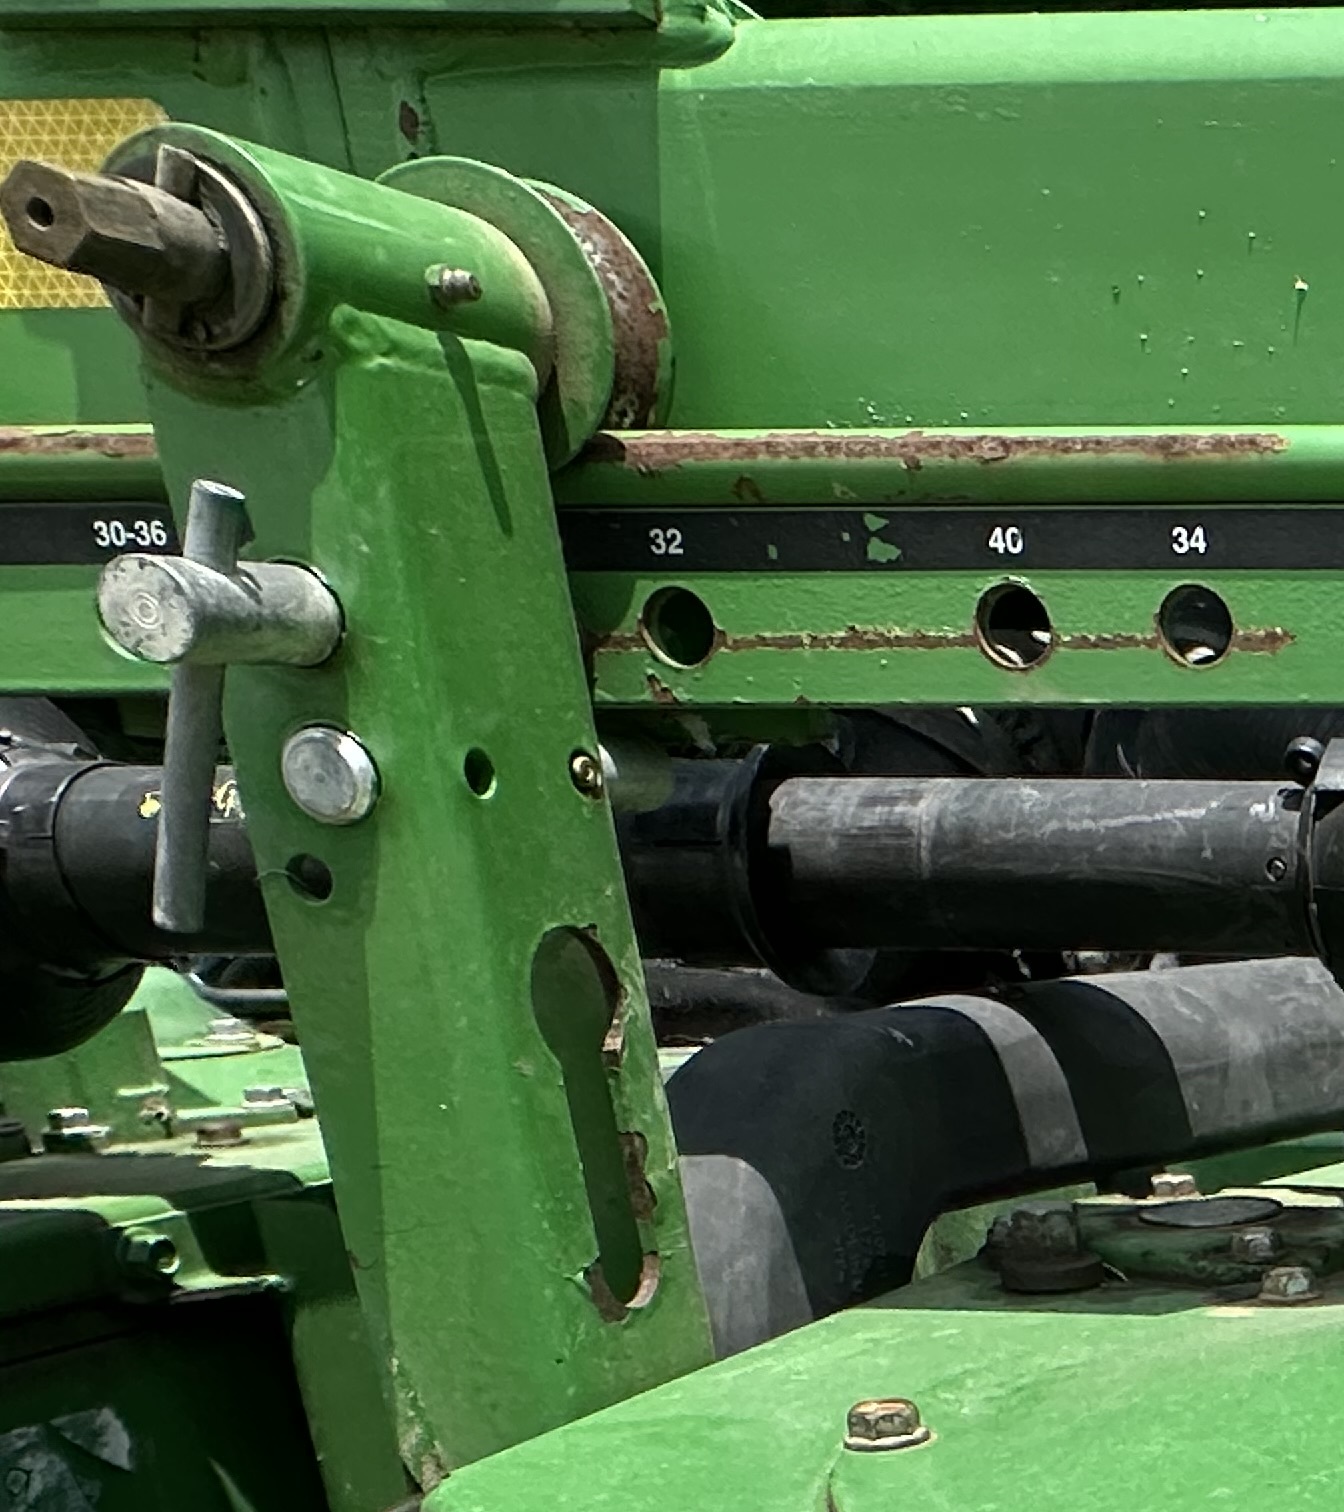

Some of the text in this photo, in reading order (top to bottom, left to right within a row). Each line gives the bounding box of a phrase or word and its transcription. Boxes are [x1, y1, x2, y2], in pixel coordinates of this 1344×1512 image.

[93, 520, 167, 547] 30-36
[649, 528, 684, 555] 32
[988, 526, 1024, 554] 40
[1172, 526, 1207, 554] 34
